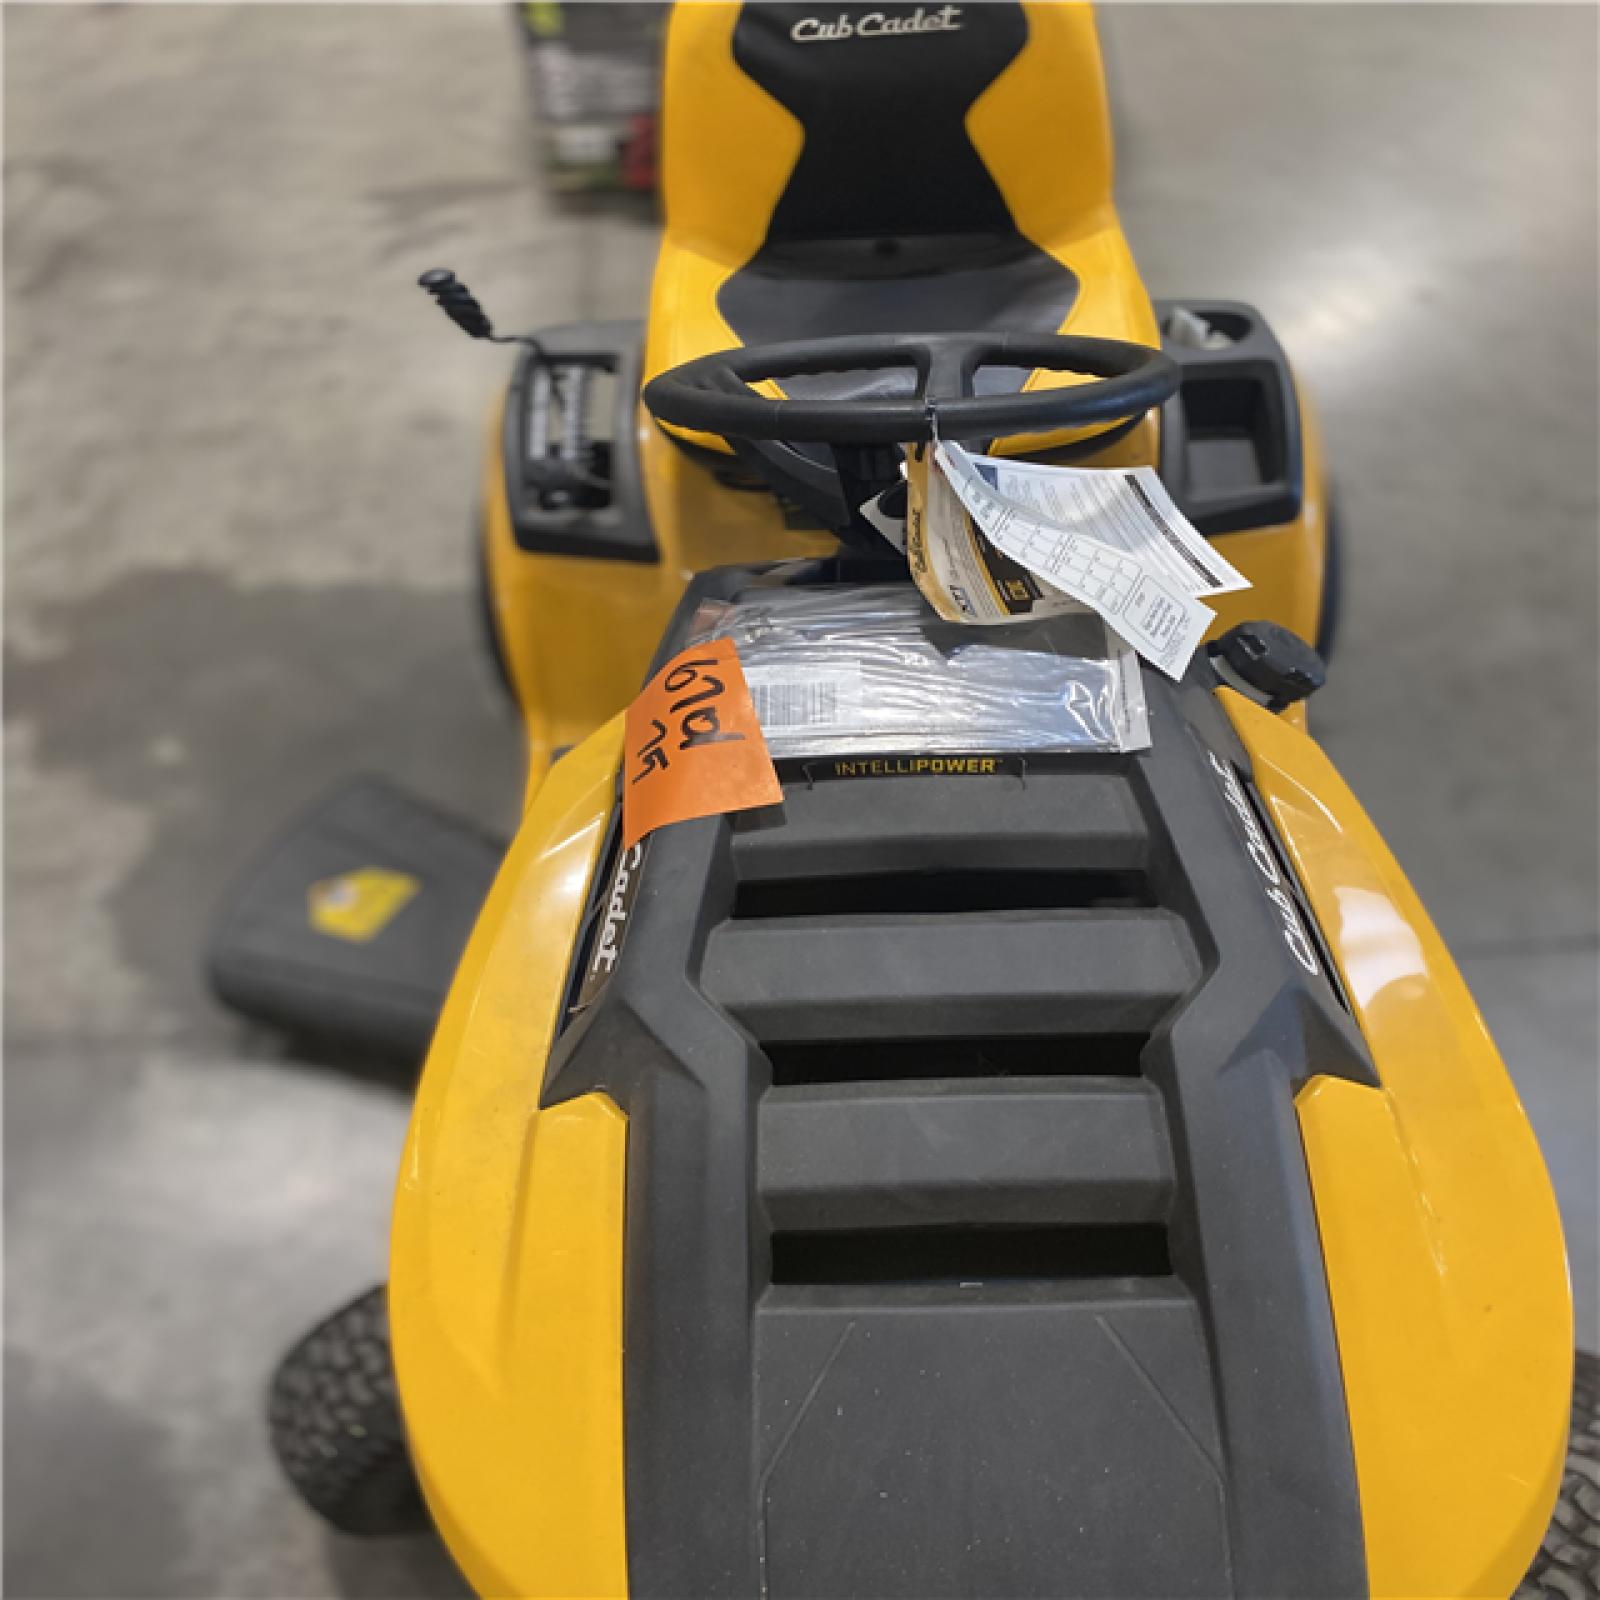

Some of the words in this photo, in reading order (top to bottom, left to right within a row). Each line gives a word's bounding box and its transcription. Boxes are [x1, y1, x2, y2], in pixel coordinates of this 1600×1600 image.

[791, 14, 853, 43] Cub
[857, 5, 962, 37] Cadet
[834, 758, 998, 777] INTELLIPOWER
[1206, 750, 1281, 885] Cadet
[1265, 886, 1319, 976] Cub
